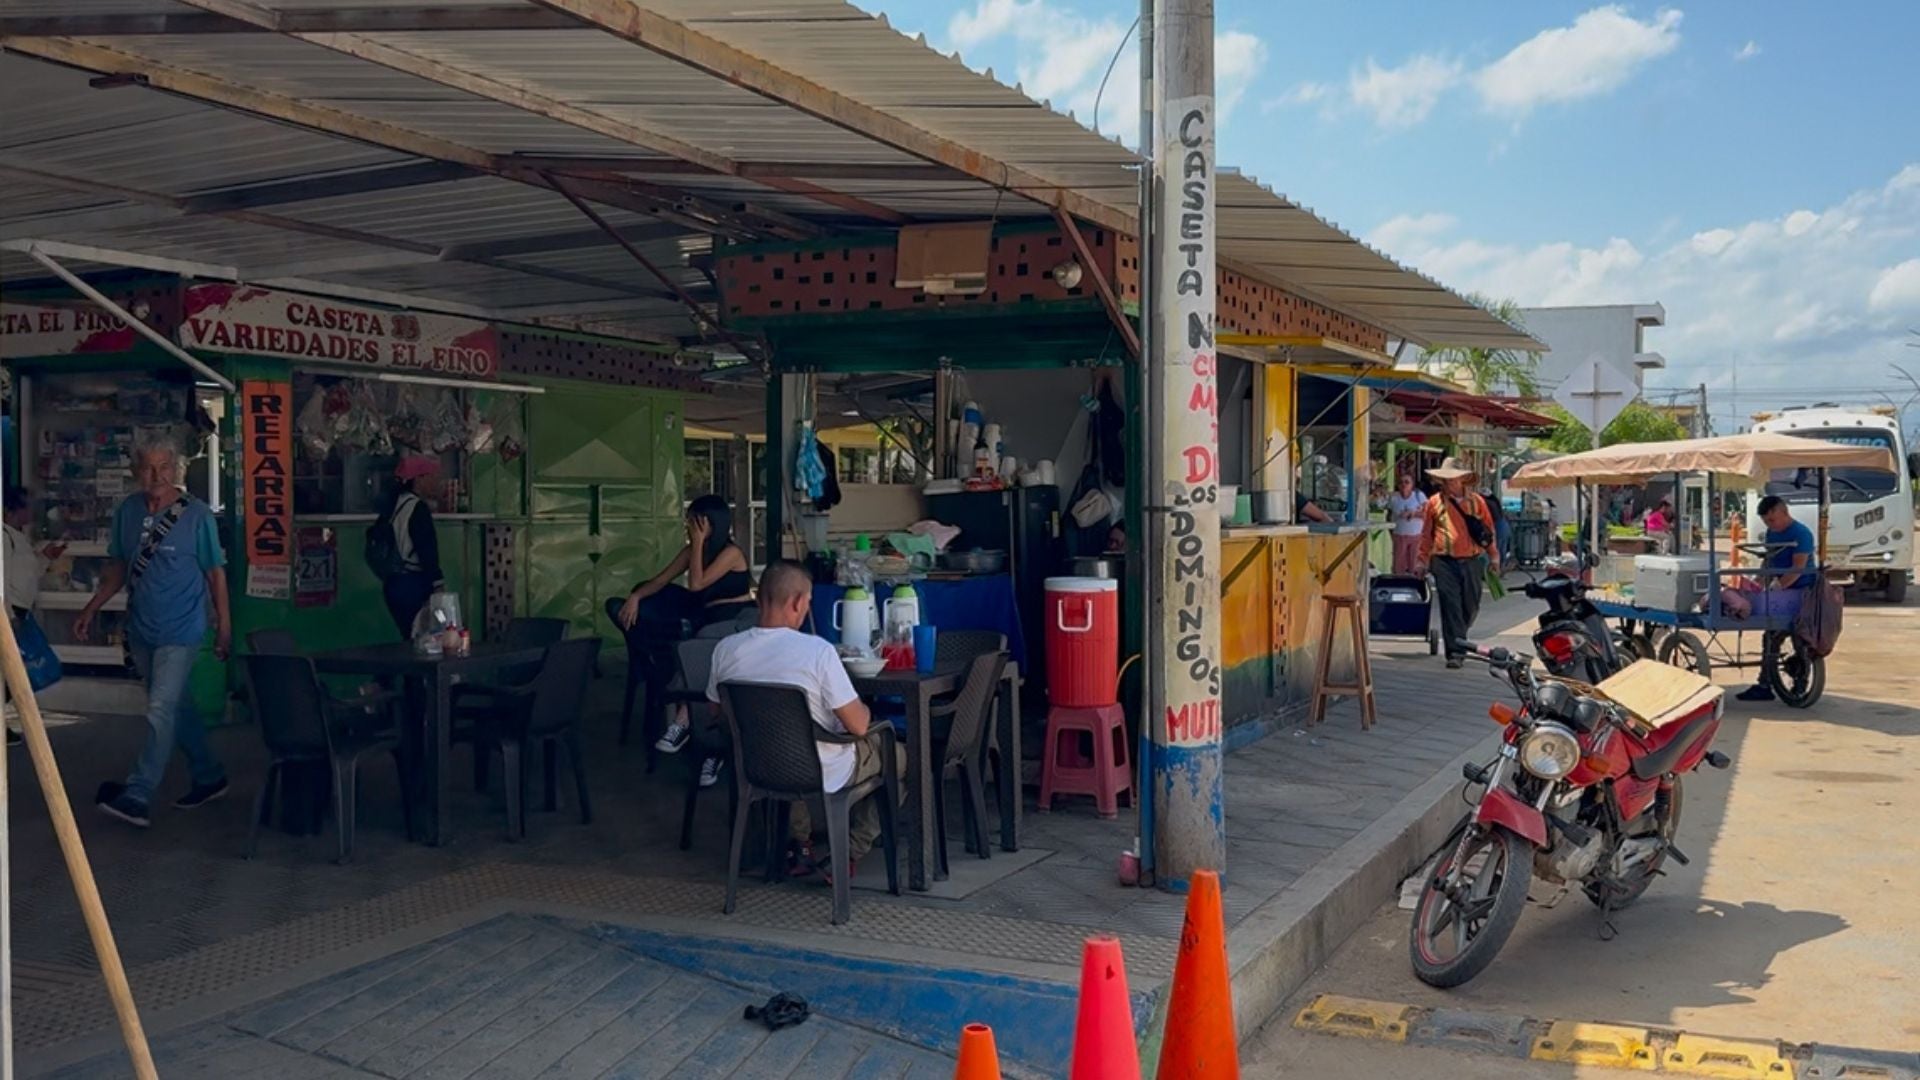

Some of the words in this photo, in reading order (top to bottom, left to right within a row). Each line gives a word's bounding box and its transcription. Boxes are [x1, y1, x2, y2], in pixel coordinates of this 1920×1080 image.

[1177, 109, 1206, 296] CASETA
[0, 313, 32, 334] TA
[38, 312, 65, 333] EL
[188, 317, 380, 363] VARIEDADES
[390, 343, 422, 367] EL
[433, 346, 490, 374] FINO
[286, 301, 384, 336] CASETA
[250, 394, 287, 556] RECARGAS
[1854, 505, 1885, 530] 609
[1170, 510, 1219, 696] DOMINGOS
